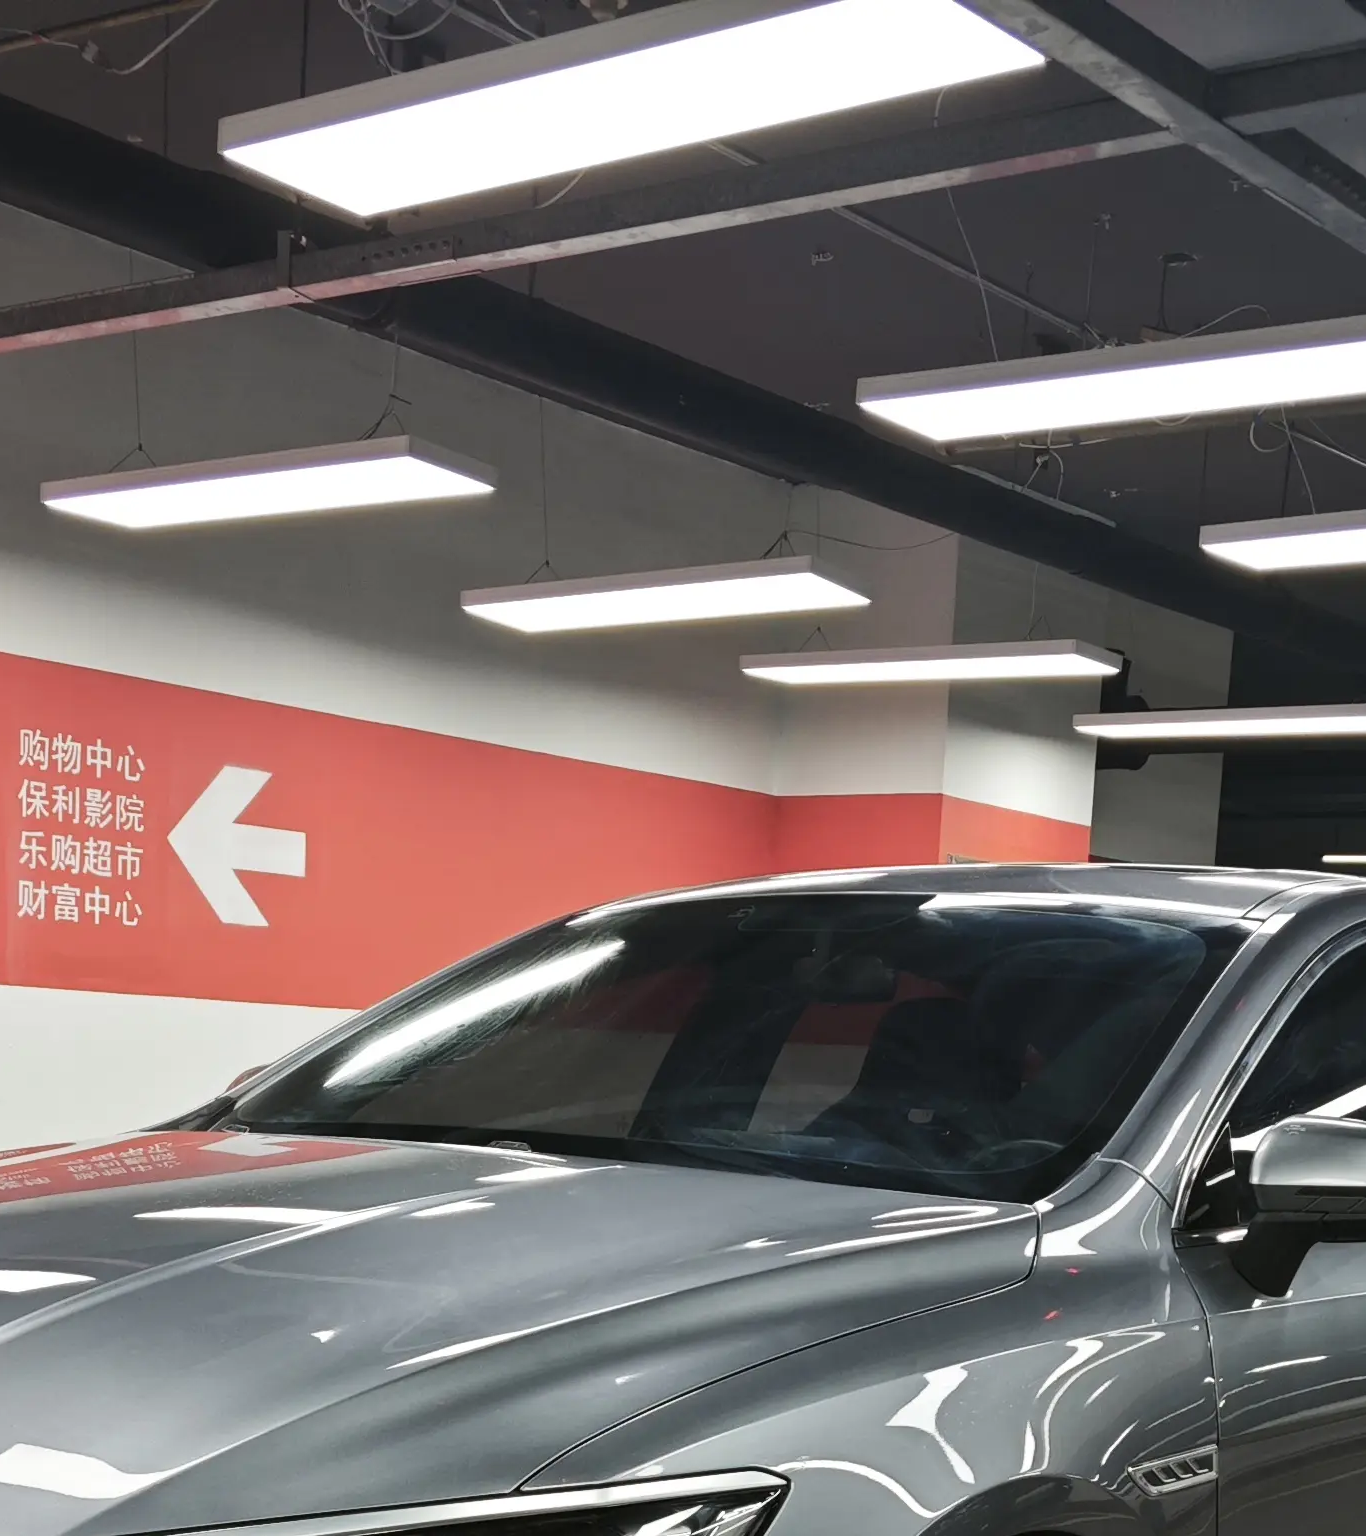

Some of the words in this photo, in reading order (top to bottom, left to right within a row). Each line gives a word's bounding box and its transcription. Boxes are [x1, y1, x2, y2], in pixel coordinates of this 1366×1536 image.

[18, 728, 146, 783] 购物中心
[17, 778, 146, 833] 保利影院
[18, 830, 145, 882] 乐购超市
[16, 879, 144, 927] 财富中心
